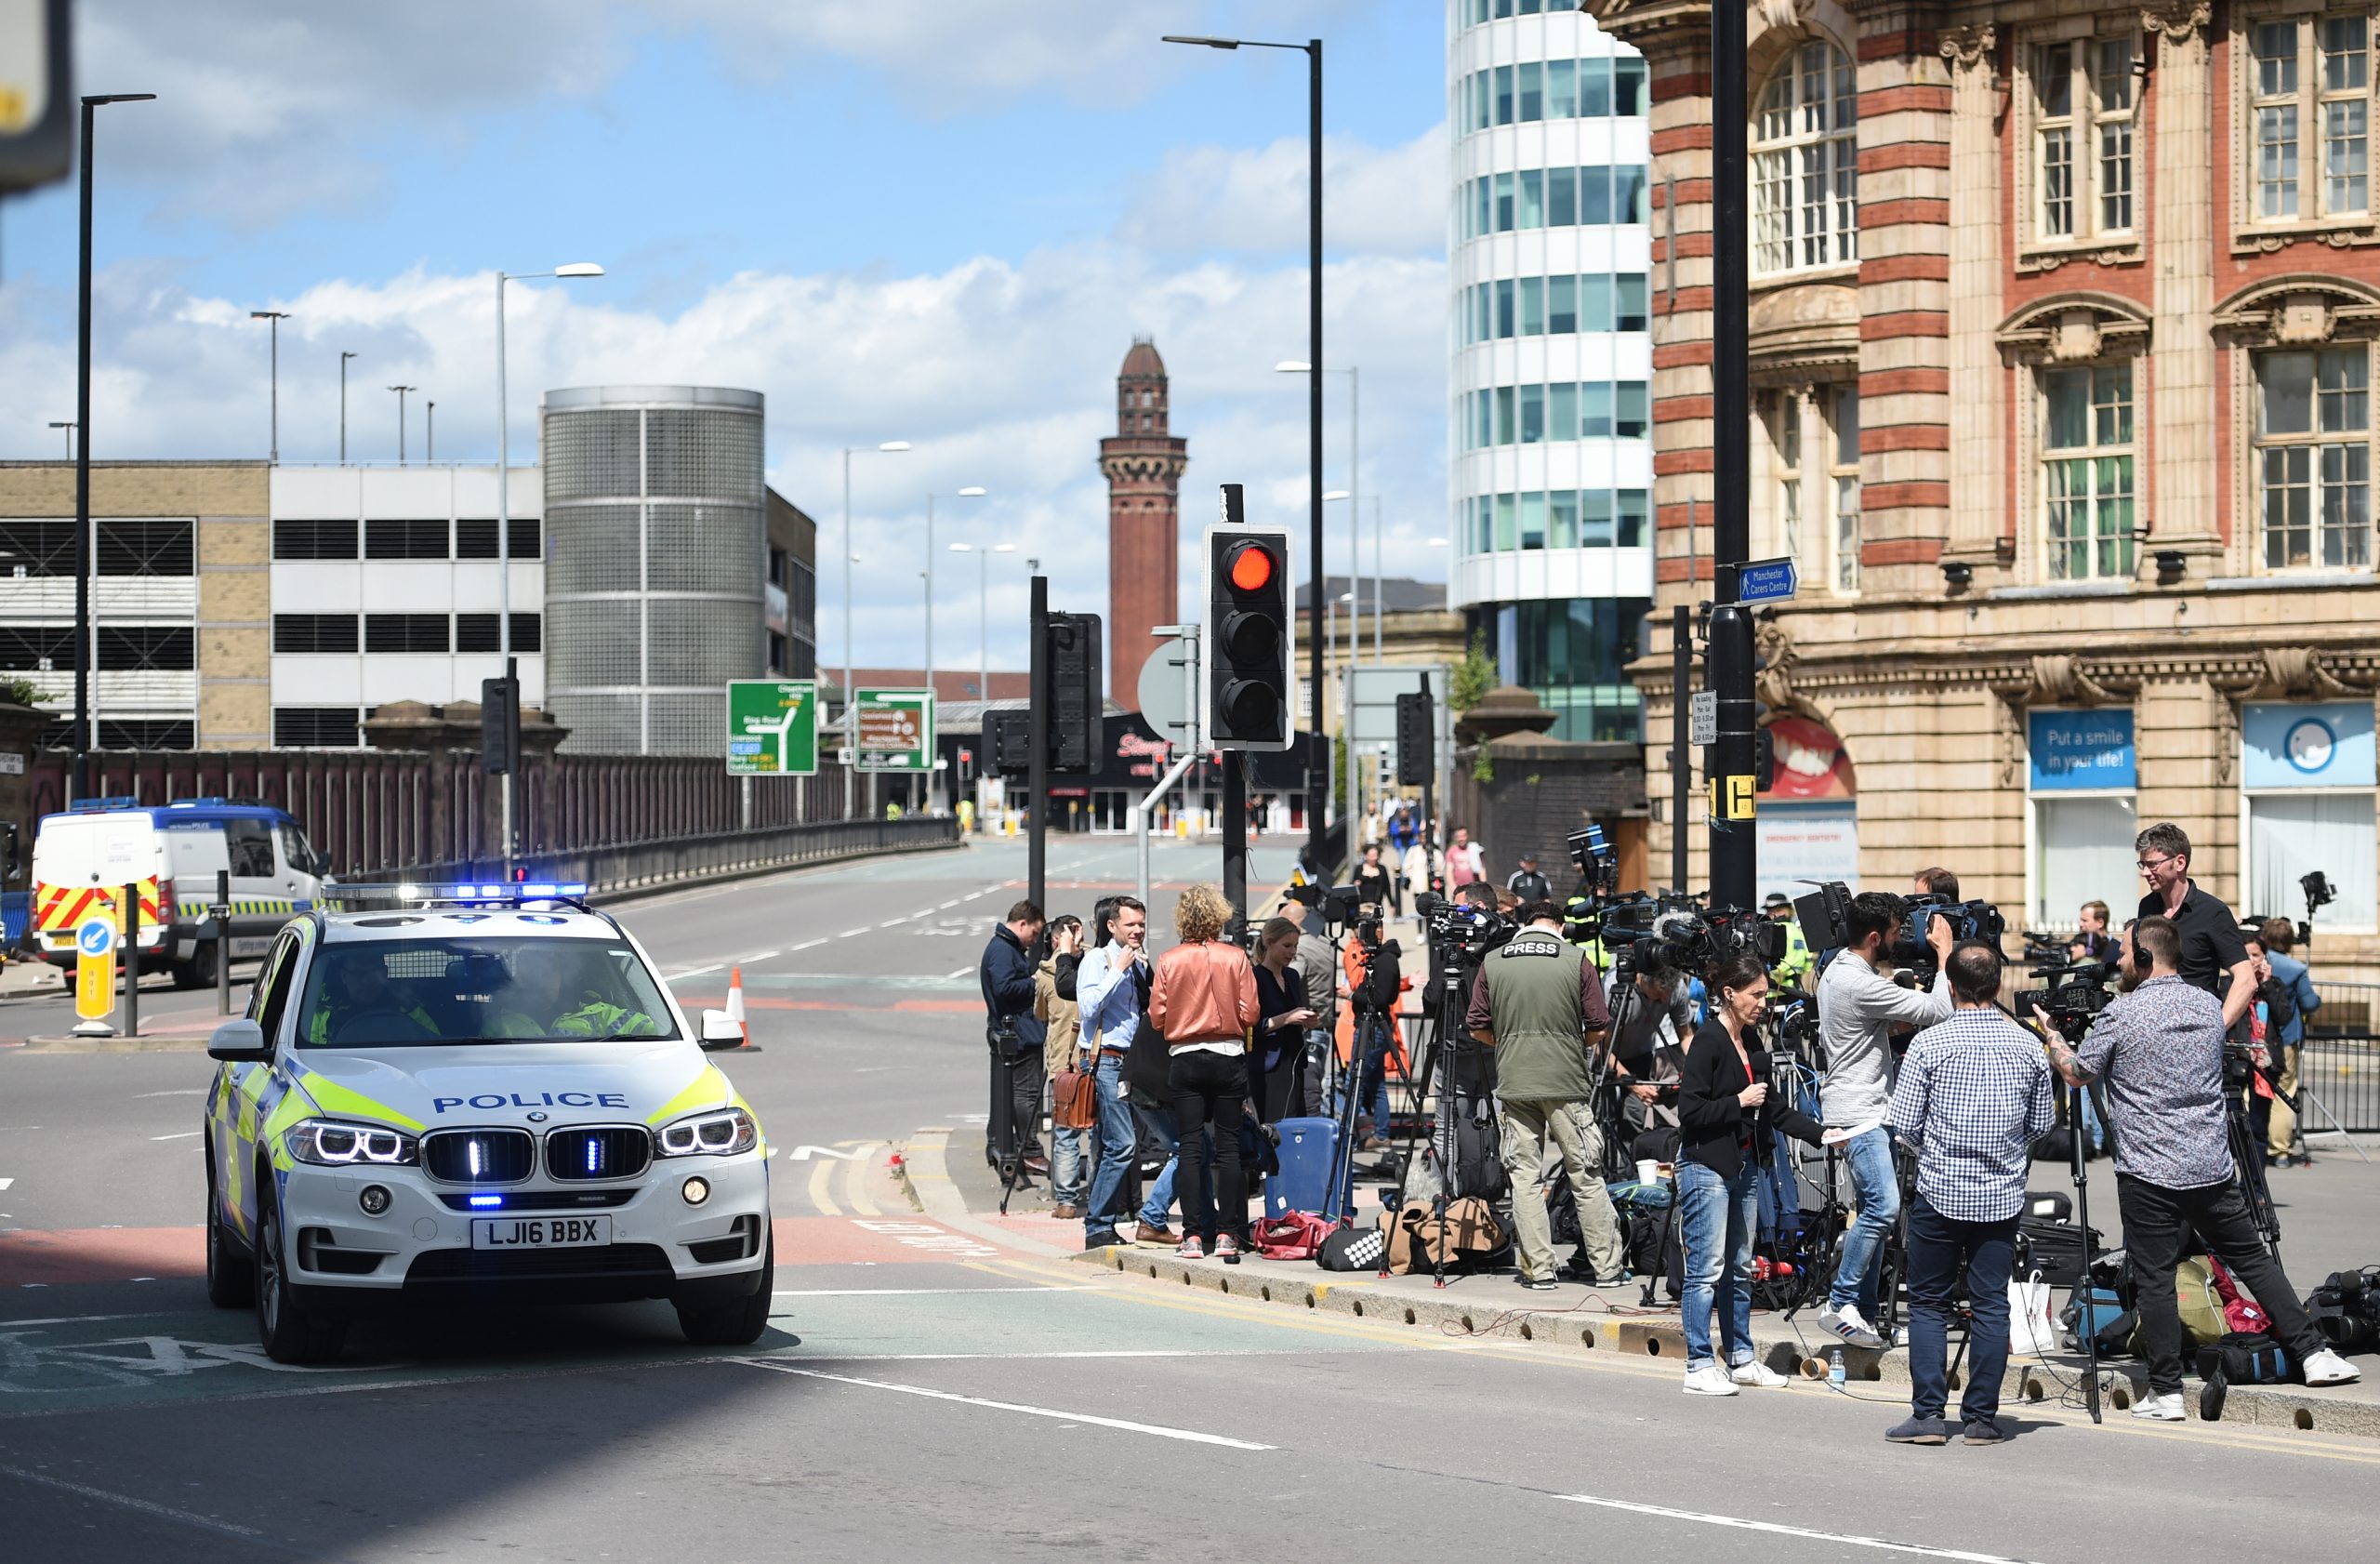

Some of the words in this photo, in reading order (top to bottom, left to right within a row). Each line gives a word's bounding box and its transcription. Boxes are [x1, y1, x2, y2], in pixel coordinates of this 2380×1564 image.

[1753, 569, 1783, 581] Manchester
[1751, 584, 1768, 594] Carers
[1768, 581, 1787, 592] Centre
[2047, 729, 2070, 745] Put
[2075, 733, 2082, 745] a
[2086, 728, 2123, 745] smile
[2048, 752, 2060, 767] in
[2063, 754, 2094, 772] your
[2096, 749, 2123, 767] life!
[1733, 781, 1754, 813] H
[1503, 943, 1557, 955] PRESS
[433, 1093, 629, 1114] POLICE
[489, 1222, 543, 1245] LJ16
[550, 1219, 597, 1242] BBX
